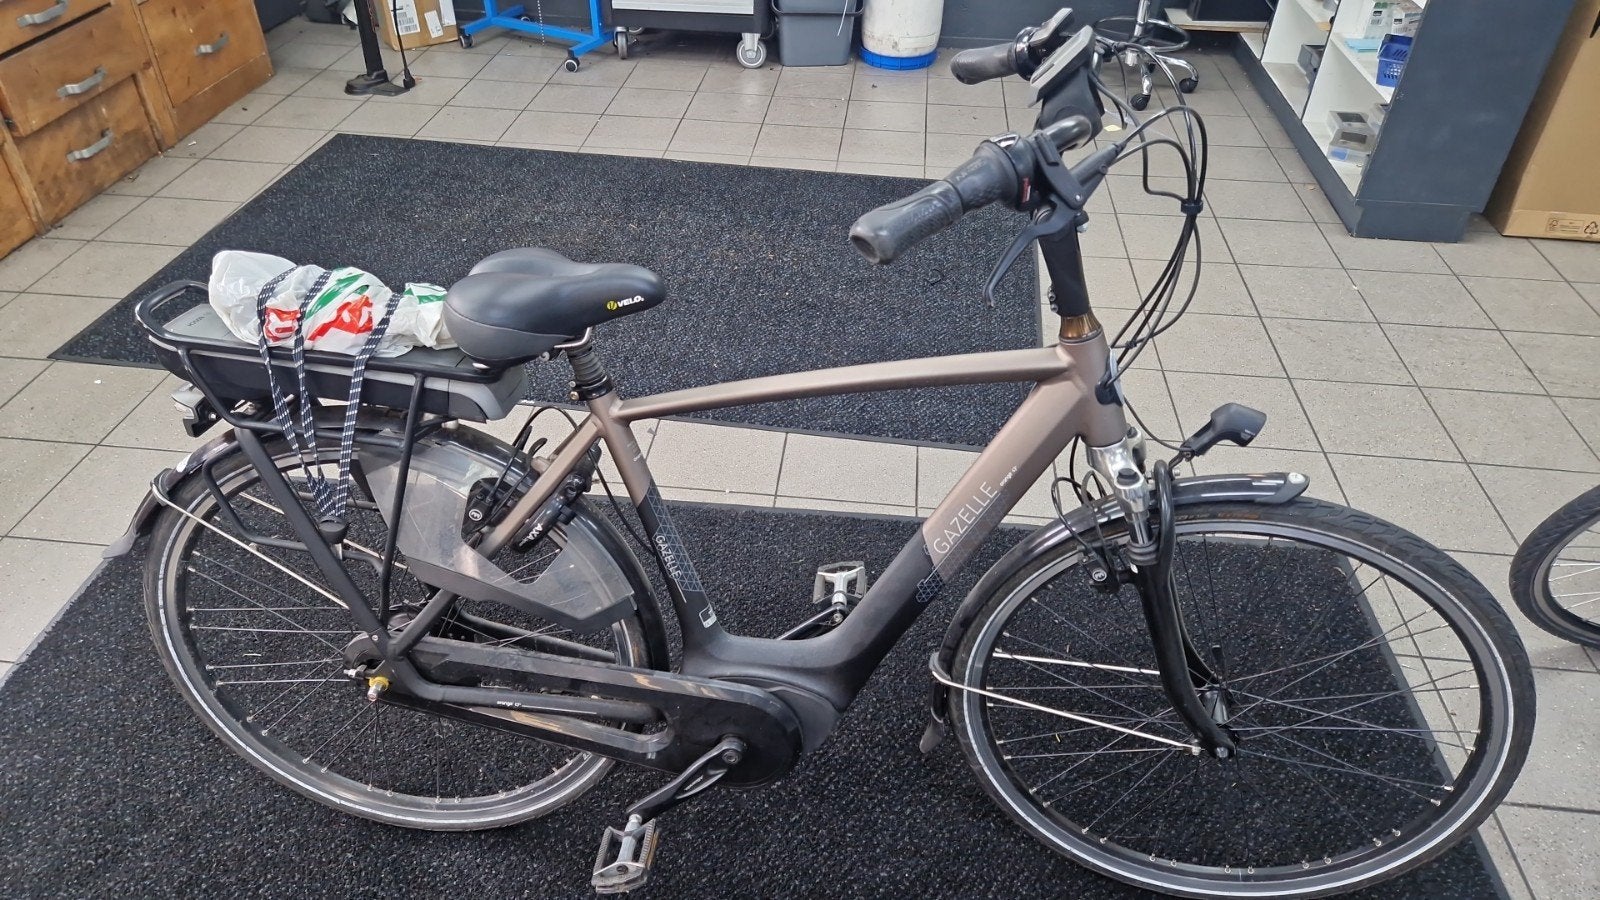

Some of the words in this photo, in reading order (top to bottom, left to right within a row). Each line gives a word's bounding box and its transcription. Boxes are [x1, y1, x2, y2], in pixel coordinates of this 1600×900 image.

[527, 522, 543, 541] AXA
[933, 481, 998, 554] GAZELLE
[655, 535, 682, 580] GAZELLE
